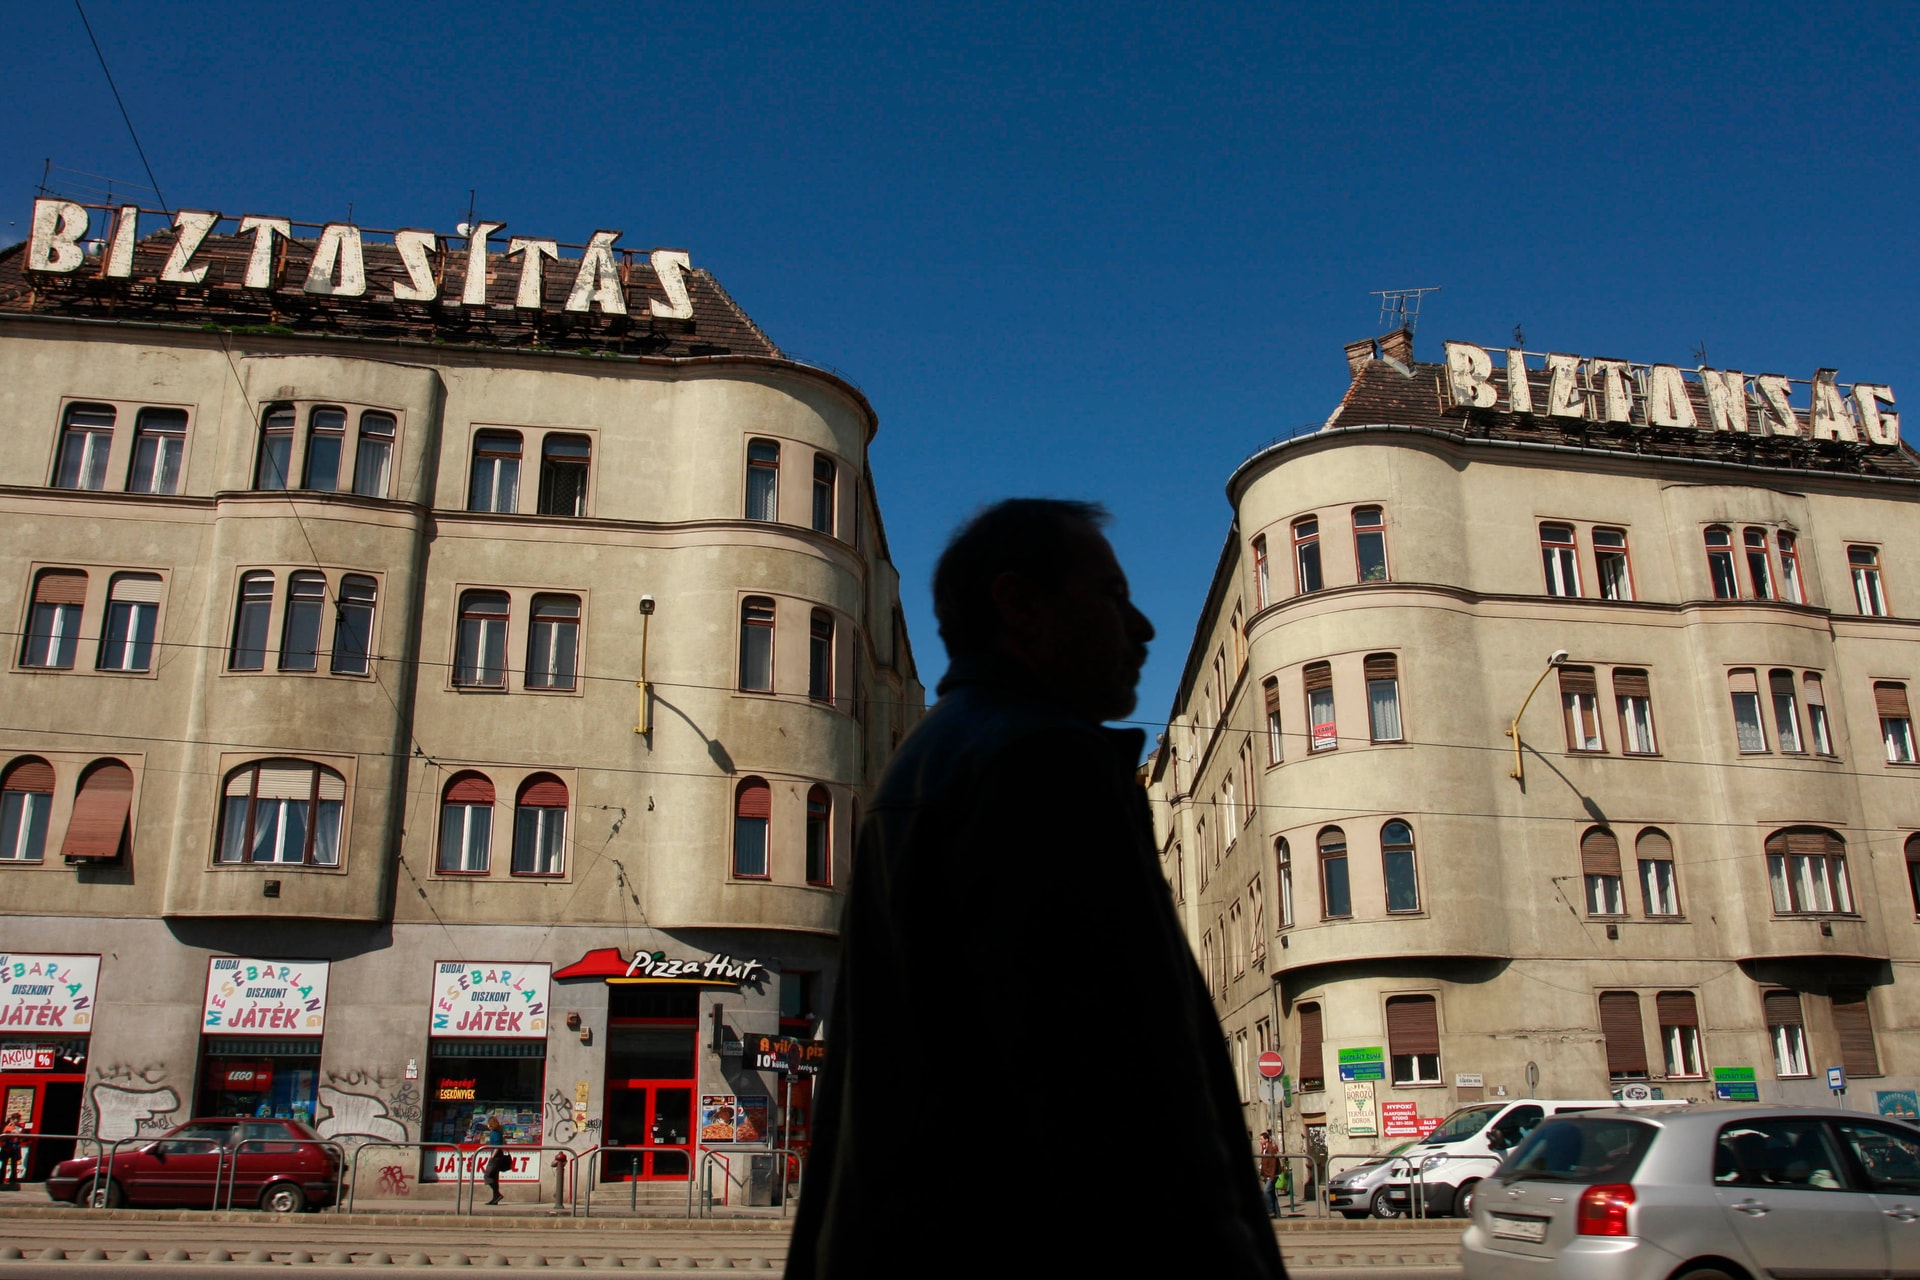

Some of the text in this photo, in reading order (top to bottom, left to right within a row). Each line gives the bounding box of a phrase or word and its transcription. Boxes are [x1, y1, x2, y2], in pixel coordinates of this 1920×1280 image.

[28, 197, 692, 320] BIZTOSÍTÁS
[1443, 340, 1900, 446] BIZTONSÁG
[214, 960, 241, 970] BUDAI
[440, 964, 465, 974] BUDAI
[626, 951, 700, 977] Pizza
[703, 953, 763, 979] Hut
[12, 984, 55, 995] DISZKONT
[206, 965, 323, 1027] MESEBARLANG
[246, 988, 288, 998] DISZKONT
[433, 969, 546, 1030] MESEBARLANG
[471, 992, 511, 1002] DISZKONT
[0, 998, 68, 1027] JÁTÉK
[228, 1001, 300, 1029] JÁTÉK
[456, 1004, 524, 1032] JÁTÉK
[760, 1038, 769, 1051] A
[774, 1039, 804, 1058] vilg
[228, 1071, 253, 1081] LEGO
[434, 1154, 530, 1173] JÁÉKLT
